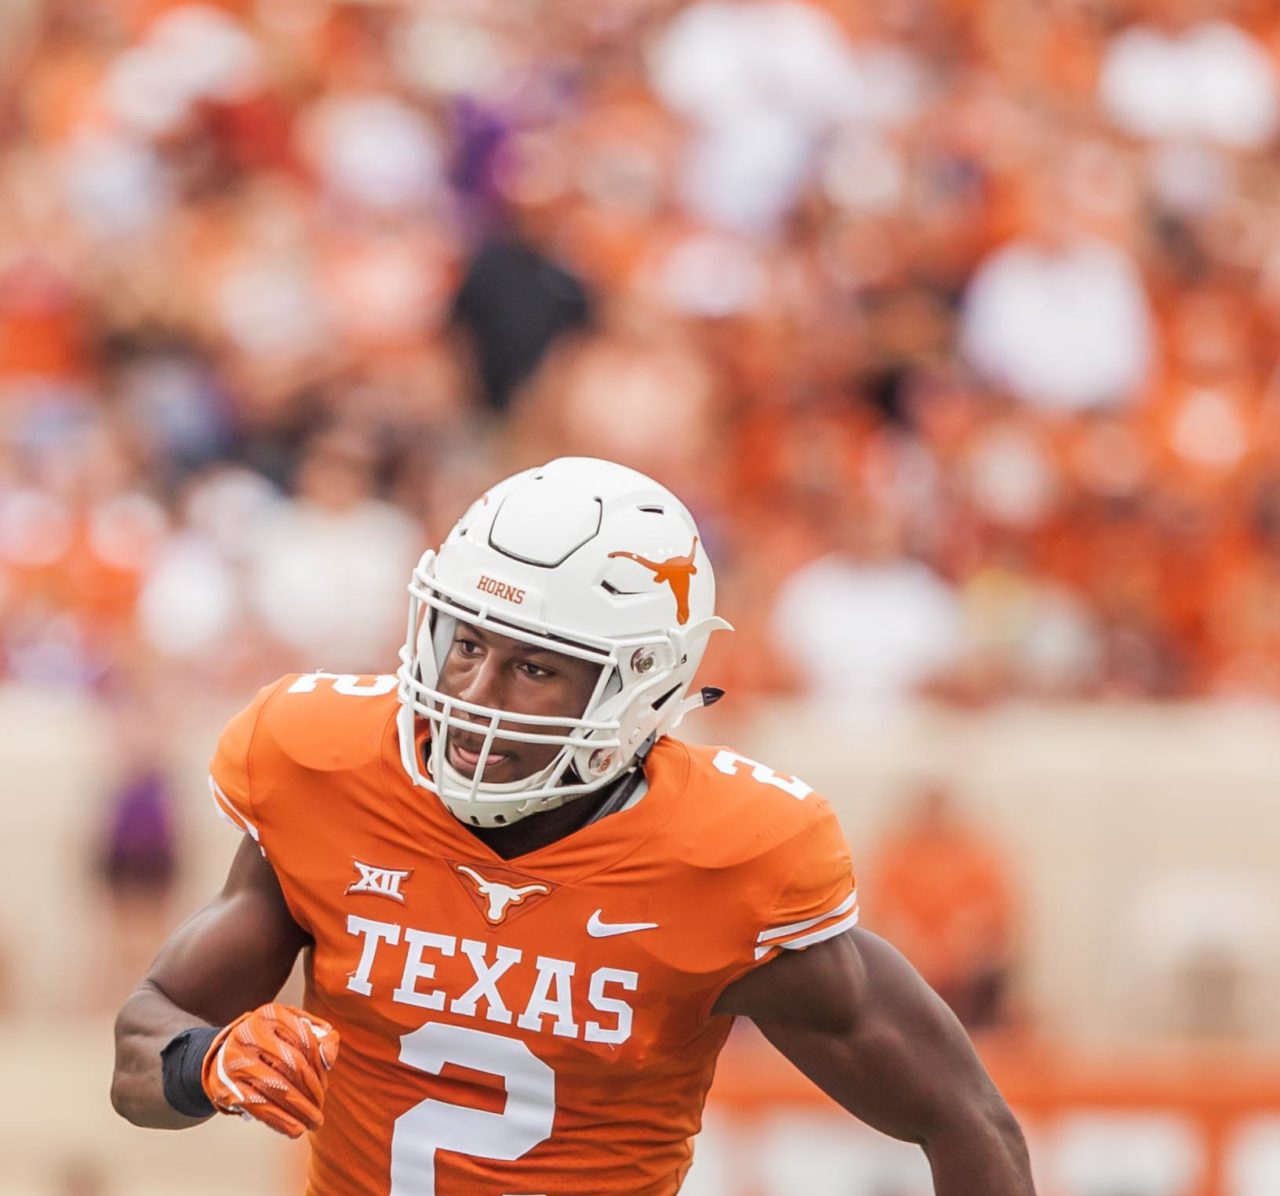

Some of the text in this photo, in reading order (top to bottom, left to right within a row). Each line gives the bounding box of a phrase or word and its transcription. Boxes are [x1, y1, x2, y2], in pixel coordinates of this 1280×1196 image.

[477, 575, 526, 605] HORNS
[349, 861, 409, 901] XII
[346, 914, 640, 1045] TEXAS
